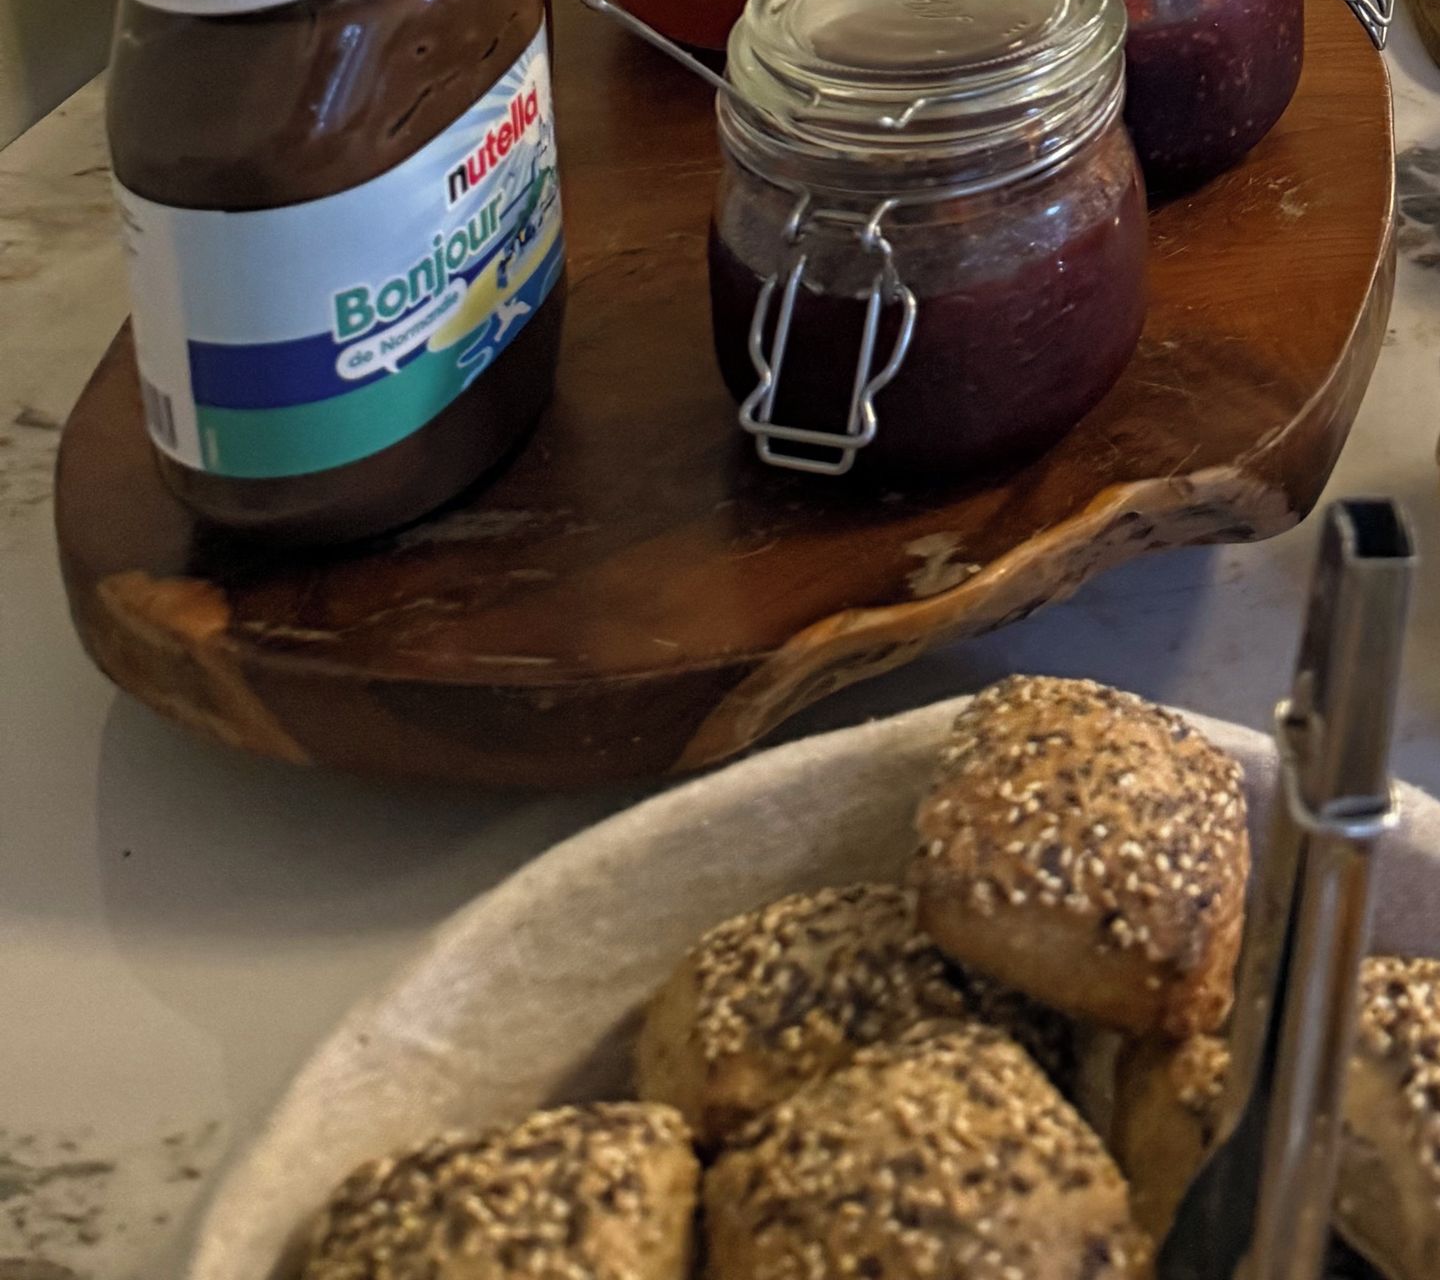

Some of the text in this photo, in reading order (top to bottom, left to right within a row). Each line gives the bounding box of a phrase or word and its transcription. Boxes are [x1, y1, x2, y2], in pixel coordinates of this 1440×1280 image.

[449, 87, 539, 204] nutella
[335, 194, 502, 339] Bonjour
[348, 346, 373, 368] de
